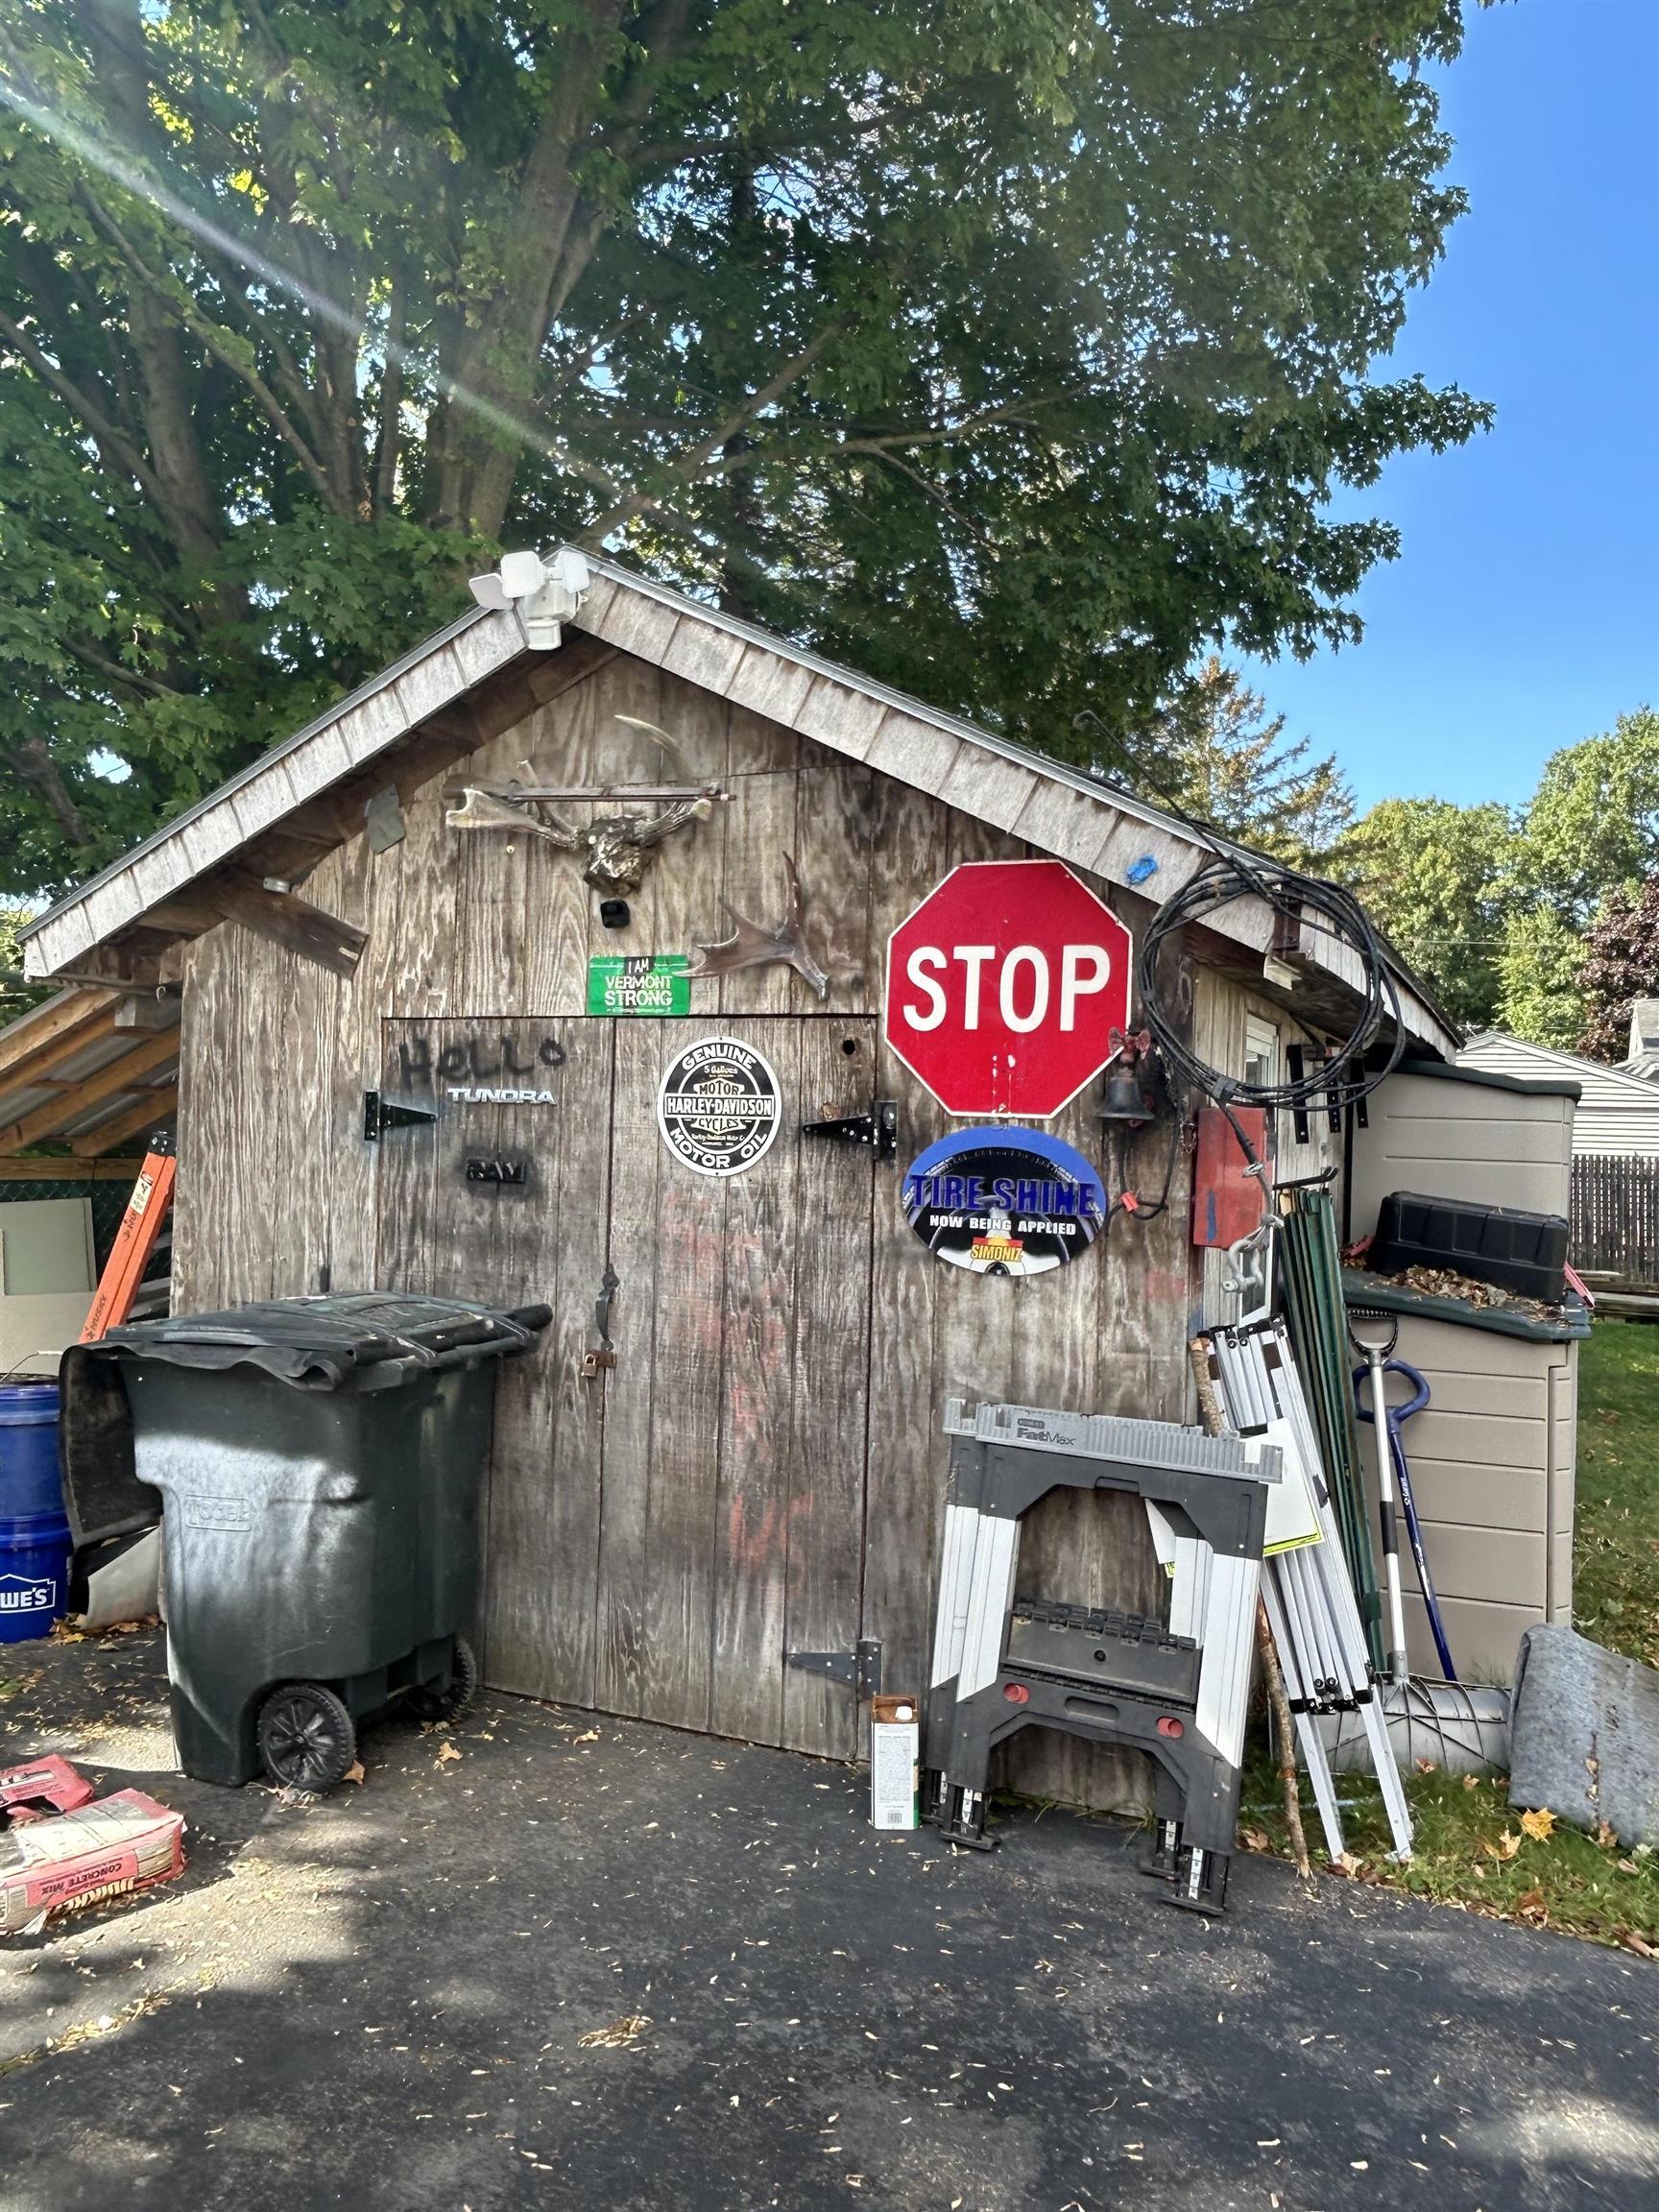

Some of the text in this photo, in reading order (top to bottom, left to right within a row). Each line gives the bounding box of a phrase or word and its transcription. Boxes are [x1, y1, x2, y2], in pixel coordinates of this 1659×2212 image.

[627, 957, 650, 974] I AM
[604, 974, 674, 991] VERMONT
[902, 945, 1111, 1034] STOP
[604, 990, 674, 1007] STRONG
[681, 1044, 757, 1071] GENUINE
[698, 1080, 740, 1095] MOTOR
[447, 1088, 557, 1106] TUNDRA
[697, 1118, 740, 1133] CYCLES
[669, 1127, 768, 1169] MOTOR OIL
[908, 1174, 1097, 1217] TIRE SHINE
[929, 1214, 1077, 1237] NOW BEING APPLIED
[970, 1244, 1023, 1262] SIMONIZ
[0, 1587, 48, 1609] WE'S
[67, 1863, 123, 1887] CONCRETE
[41, 1880, 66, 1896] MIX
